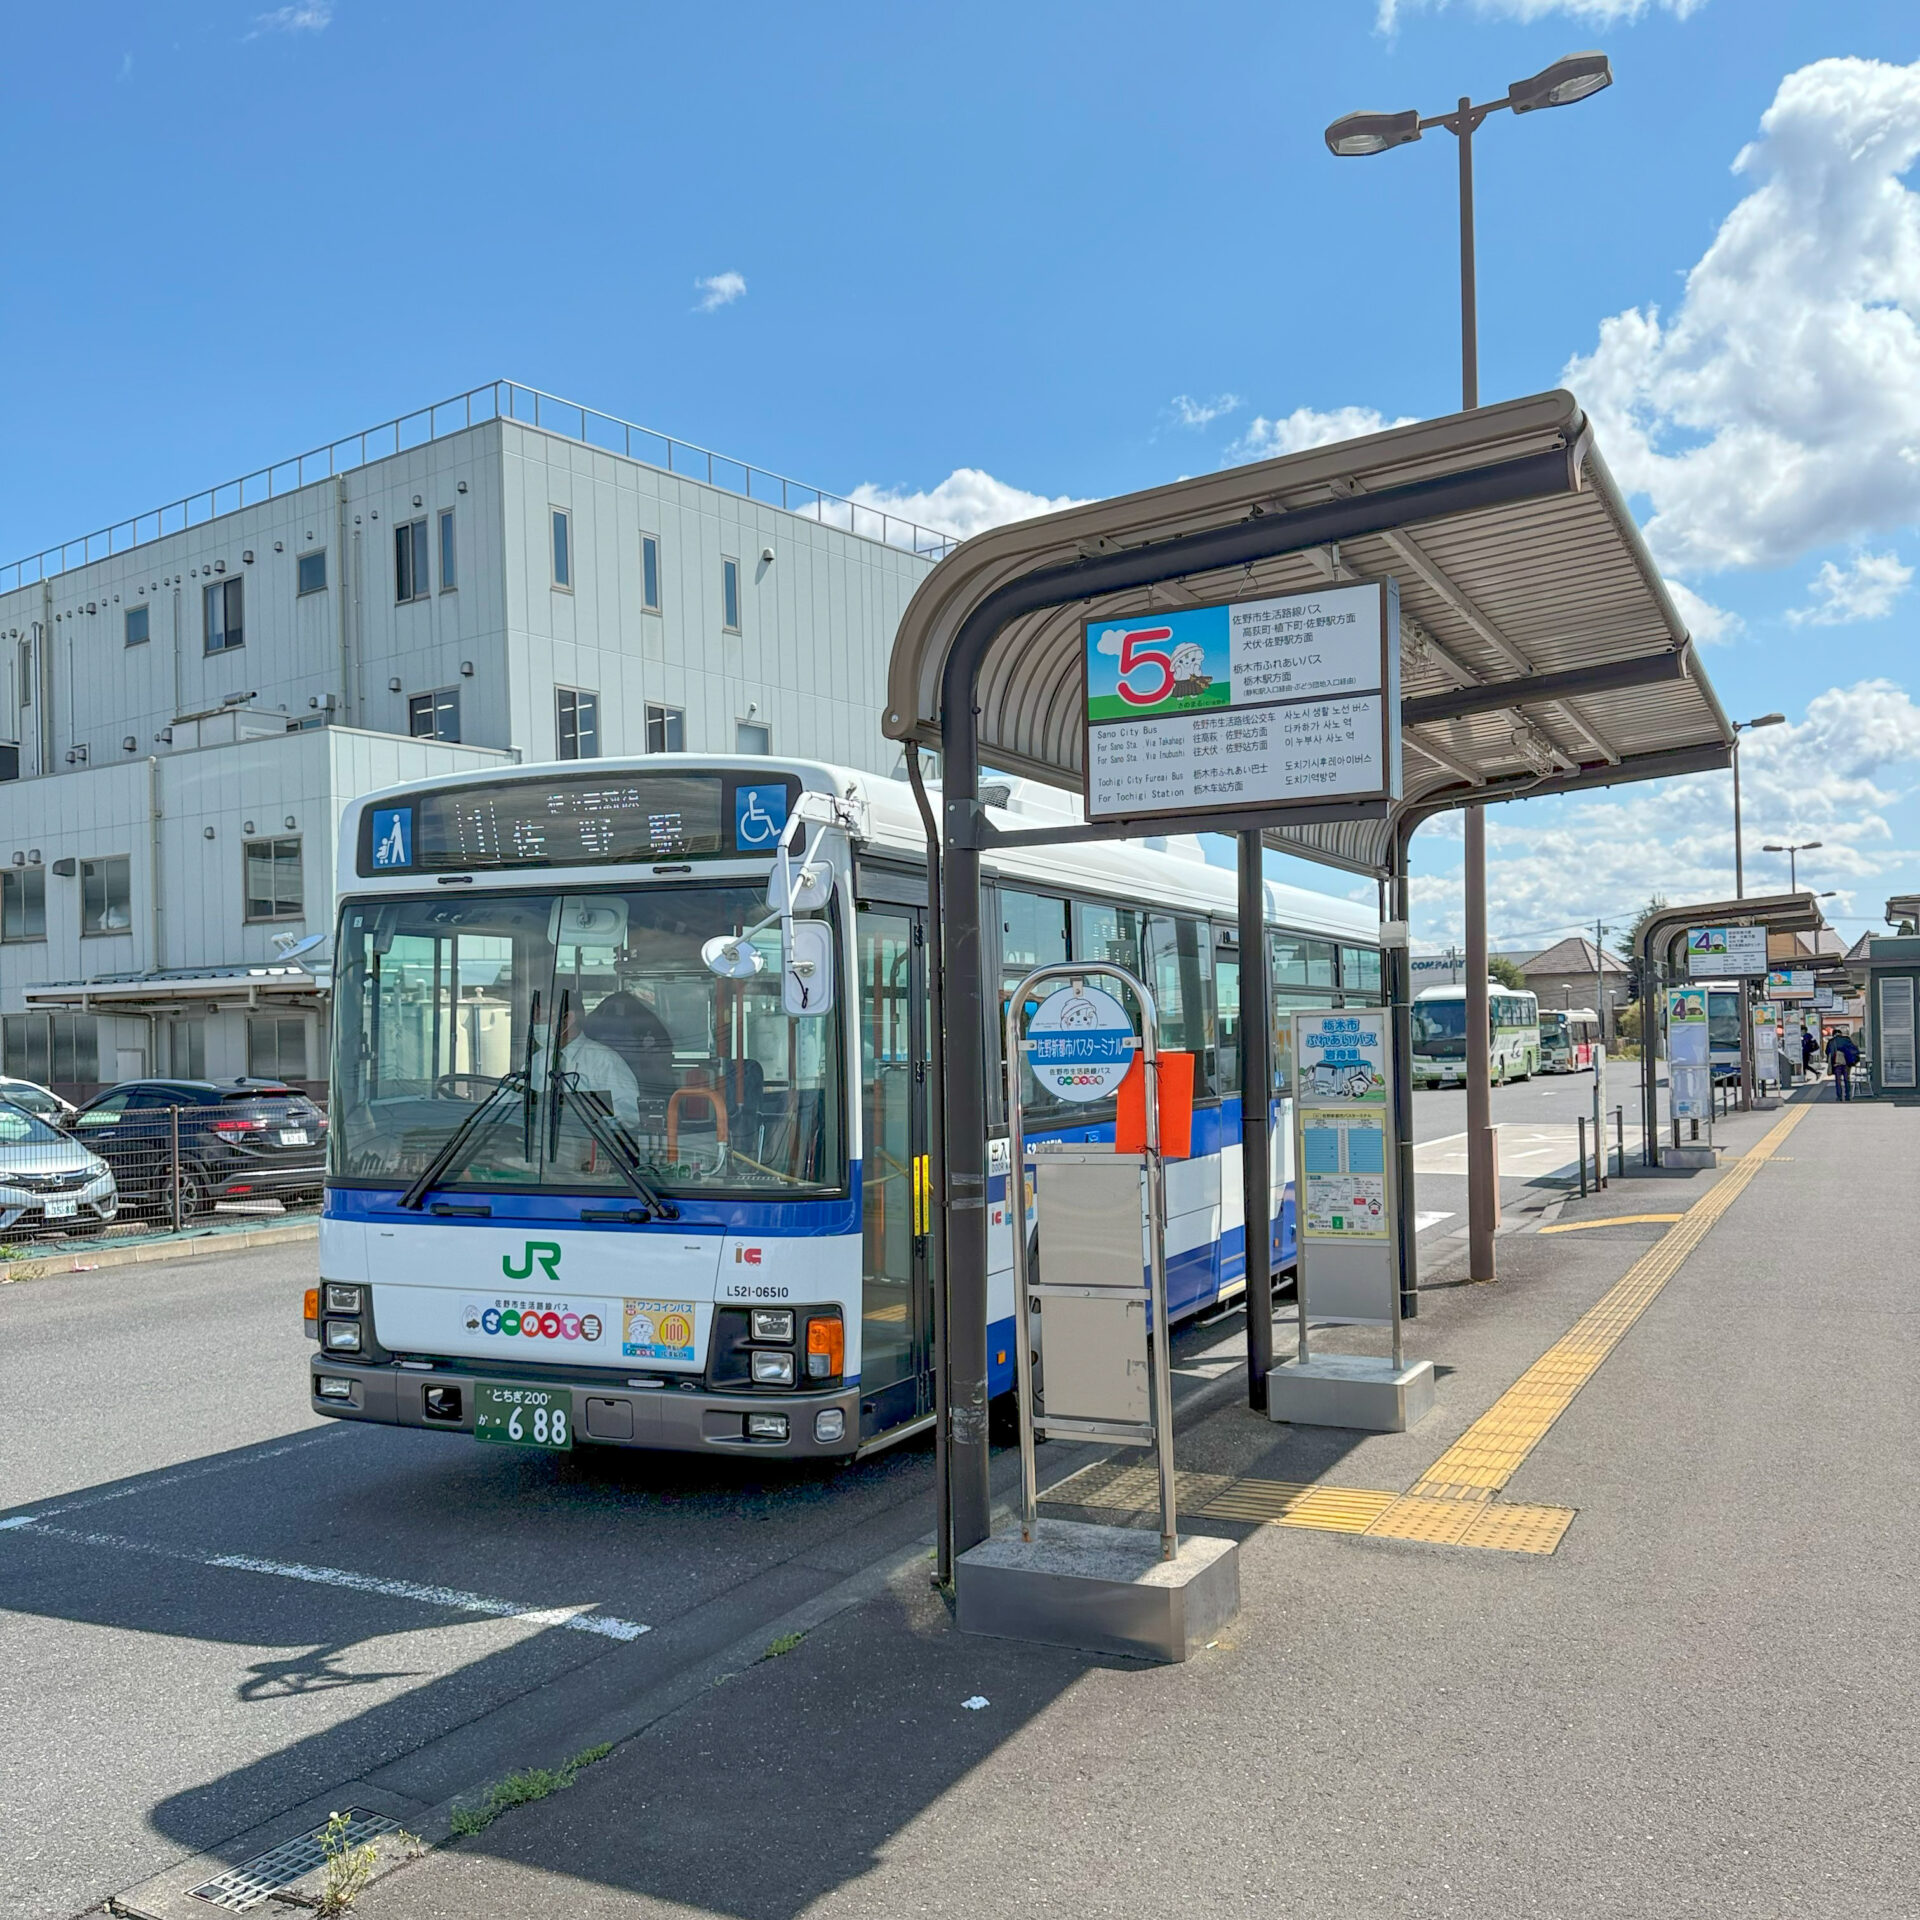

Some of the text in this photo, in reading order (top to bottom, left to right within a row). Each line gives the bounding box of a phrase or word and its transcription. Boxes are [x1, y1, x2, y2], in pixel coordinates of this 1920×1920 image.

[1232, 604, 1322, 625] 佐野市生活路線バス
[1117, 627, 1175, 705] 5
[1233, 654, 1322, 674] 栃木市ふれあいバス
[1243, 672, 1292, 686] 栃木駅方面
[1284, 708, 1310, 720] 사노시
[1352, 702, 1370, 713] 버스
[1193, 711, 1276, 730] 佐野市生活路线公交车
[1097, 726, 1158, 739] Sano City Bus
[1097, 743, 1107, 752] For
[1110, 742, 1123, 751] Sano
[1097, 757, 1107, 765] For
[1110, 755, 1124, 764] Sano
[1098, 772, 1184, 788] Tochigi City Fureai Bus
[1193, 780, 1244, 795] 栃木车站方面
[1098, 788, 1184, 803] For Tochigi Station
[1694, 932, 1712, 952] 4
[1411, 959, 1465, 970] COMPANY
[1773, 973, 1783, 985] 3
[1672, 998, 1687, 1020] 4
[1755, 1009, 1765, 1024] 3
[1323, 1018, 1360, 1033] 栃木市
[1037, 1037, 1123, 1058] 佐野新都市バスターミナル
[1307, 1032, 1378, 1048] ふれあいバス
[502, 1241, 561, 1280] JR
[727, 1286, 789, 1298] L521-06510
[494, 1299, 569, 1311] 佐野市生活路線バス
[637, 1301, 692, 1313] ワンコインバス
[484, 1310, 601, 1340] さーのって号
[665, 1323, 683, 1341] 100
